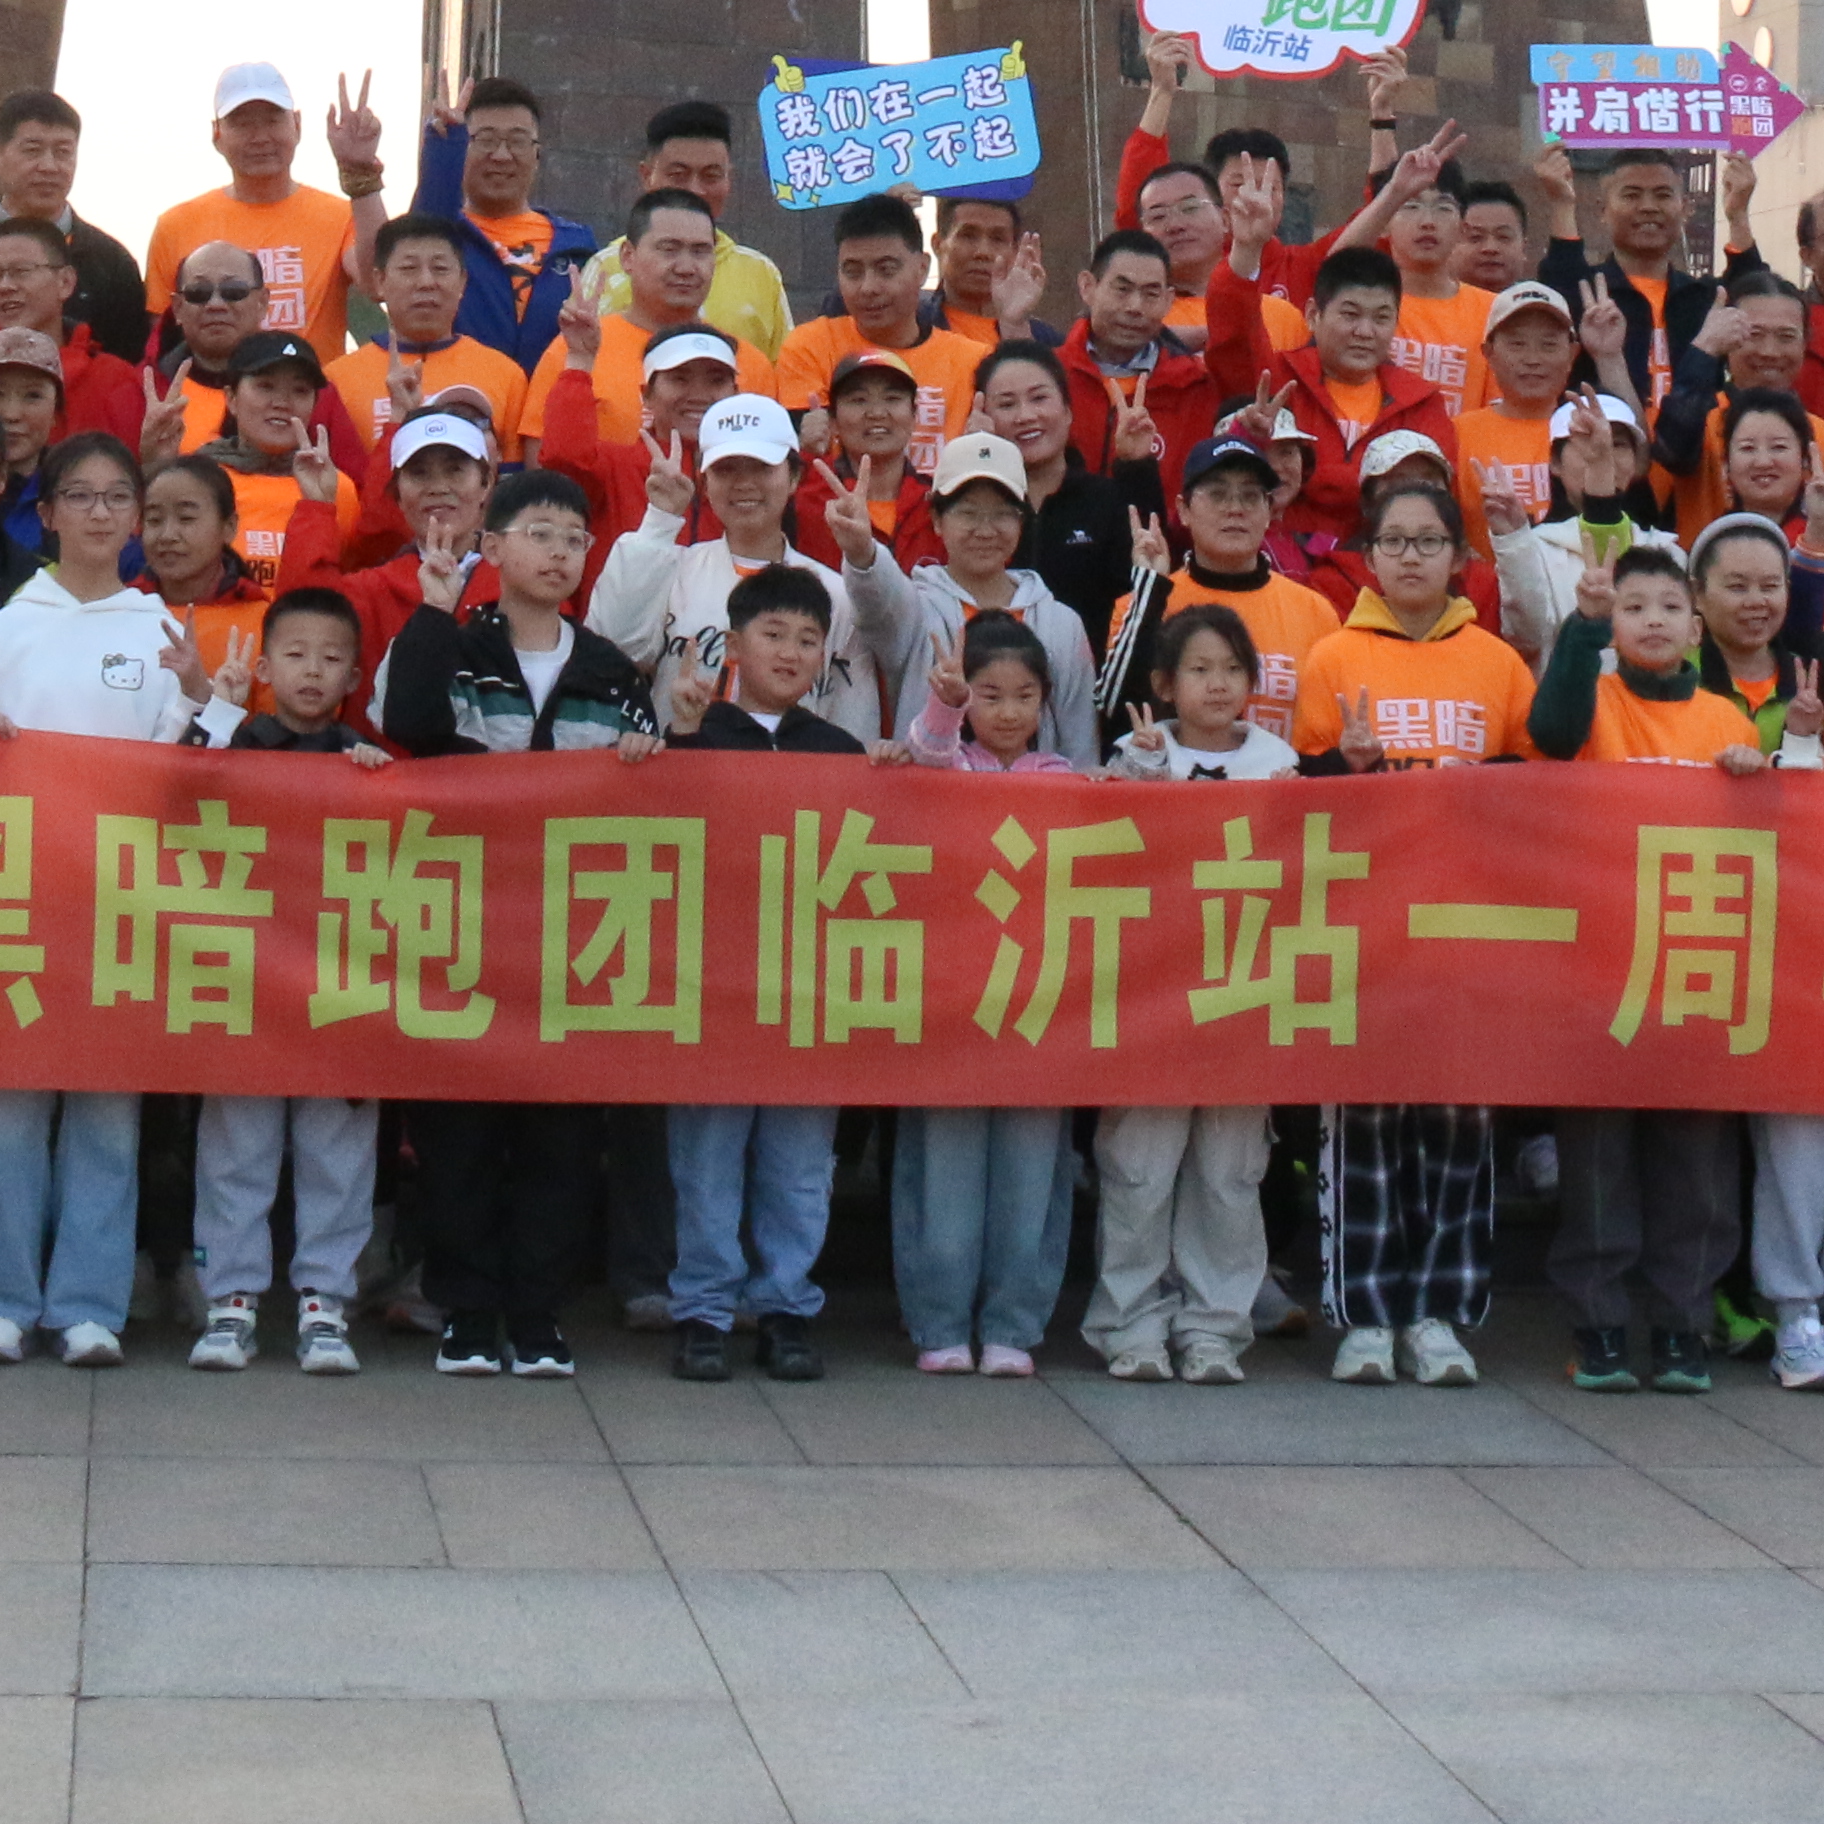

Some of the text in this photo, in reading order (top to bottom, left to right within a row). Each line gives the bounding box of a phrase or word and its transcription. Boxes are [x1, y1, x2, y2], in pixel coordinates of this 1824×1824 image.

[1223, 24, 1313, 62] 临沂站
[776, 64, 1007, 140] 我们在一起
[1547, 86, 1726, 134] 并肩偕行
[1729, 95, 1774, 116] 黑暗
[782, 116, 1017, 191] 就会了不起
[256, 246, 301, 284] 暗
[1375, 697, 1487, 754] 黑暗
